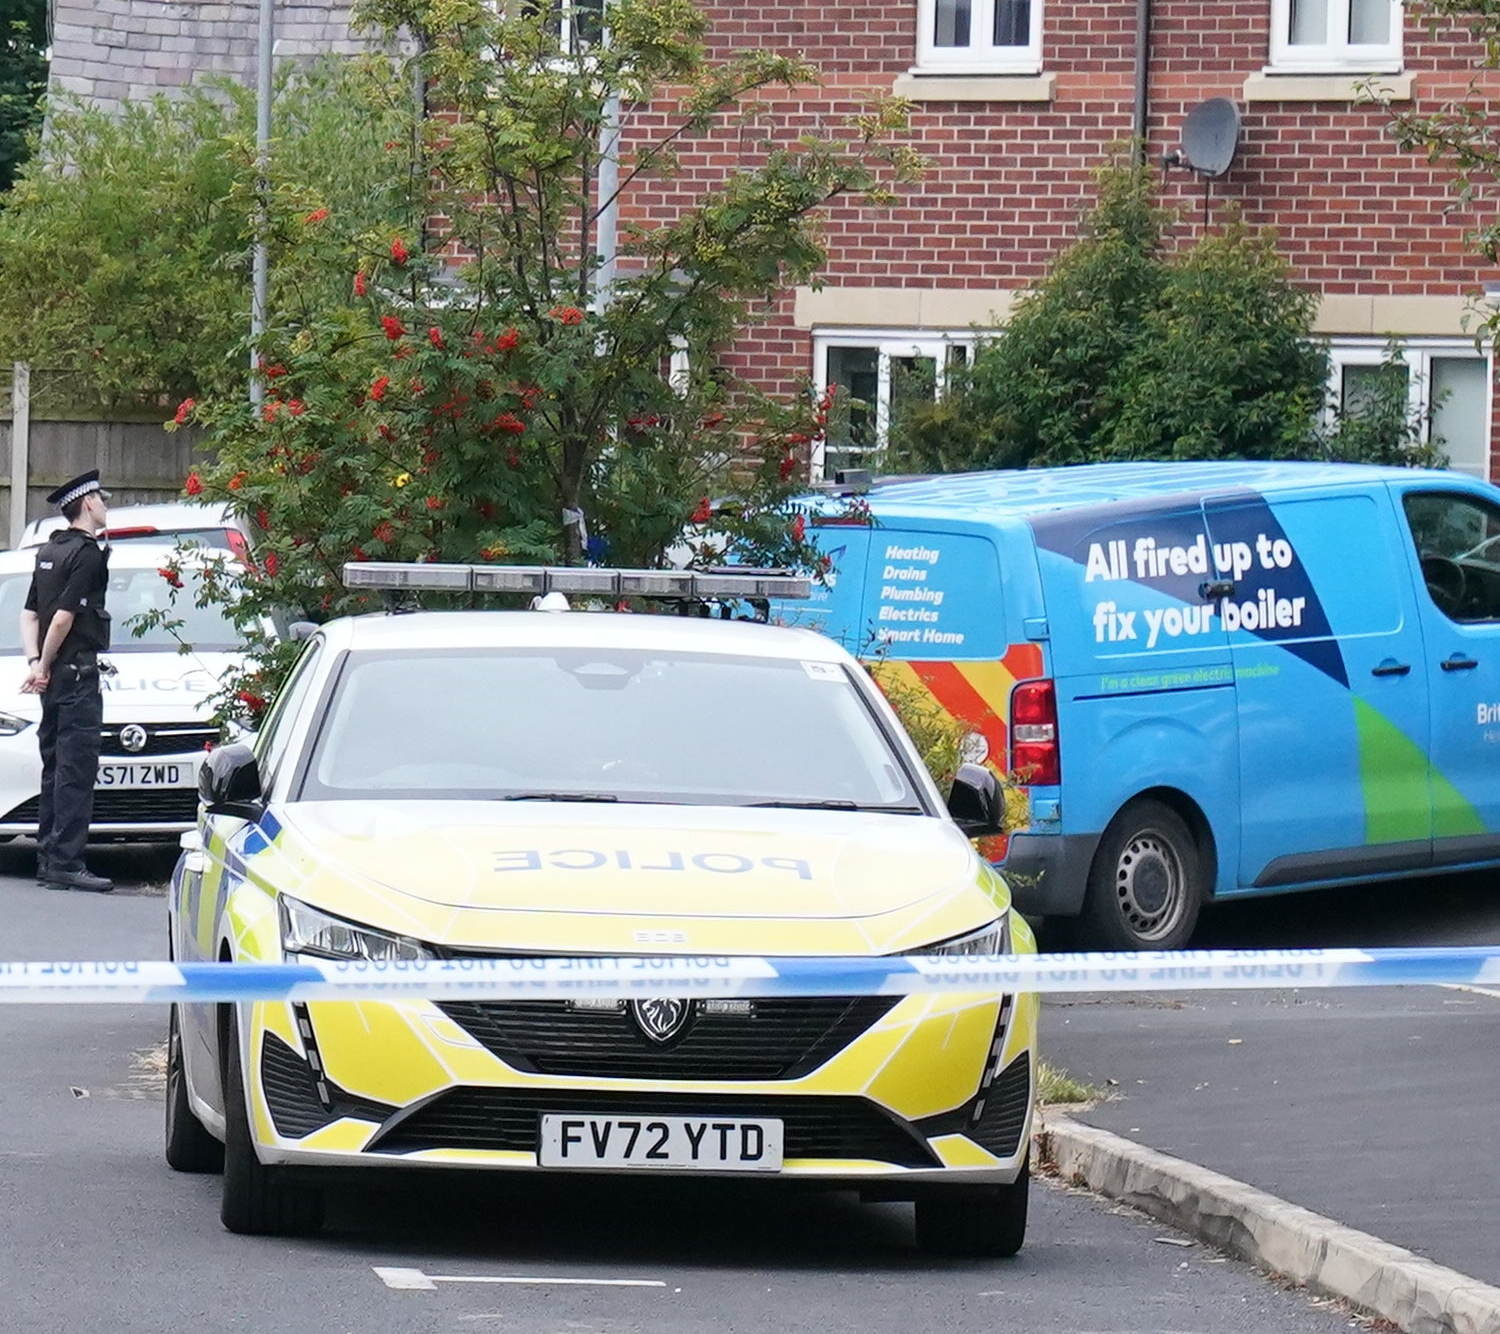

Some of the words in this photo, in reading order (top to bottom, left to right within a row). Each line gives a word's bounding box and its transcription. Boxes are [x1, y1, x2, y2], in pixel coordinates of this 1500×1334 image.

[885, 545, 940, 564] Heating
[1085, 540, 1129, 583] All
[1133, 534, 1207, 579] fired
[1213, 541, 1252, 581] up
[1256, 534, 1293, 569] to
[883, 566, 927, 581] Drains
[880, 586, 944, 606] Plumbing
[879, 607, 939, 622] Electrics
[1093, 601, 1138, 643] fix
[1143, 603, 1215, 649] your
[1220, 588, 1306, 632] boiler
[877, 628, 921, 644] Smart
[922, 630, 965, 645] Home
[139, 765, 179, 785] ZWD
[561, 1121, 669, 1159] FV72
[684, 1123, 763, 1161] YTD
